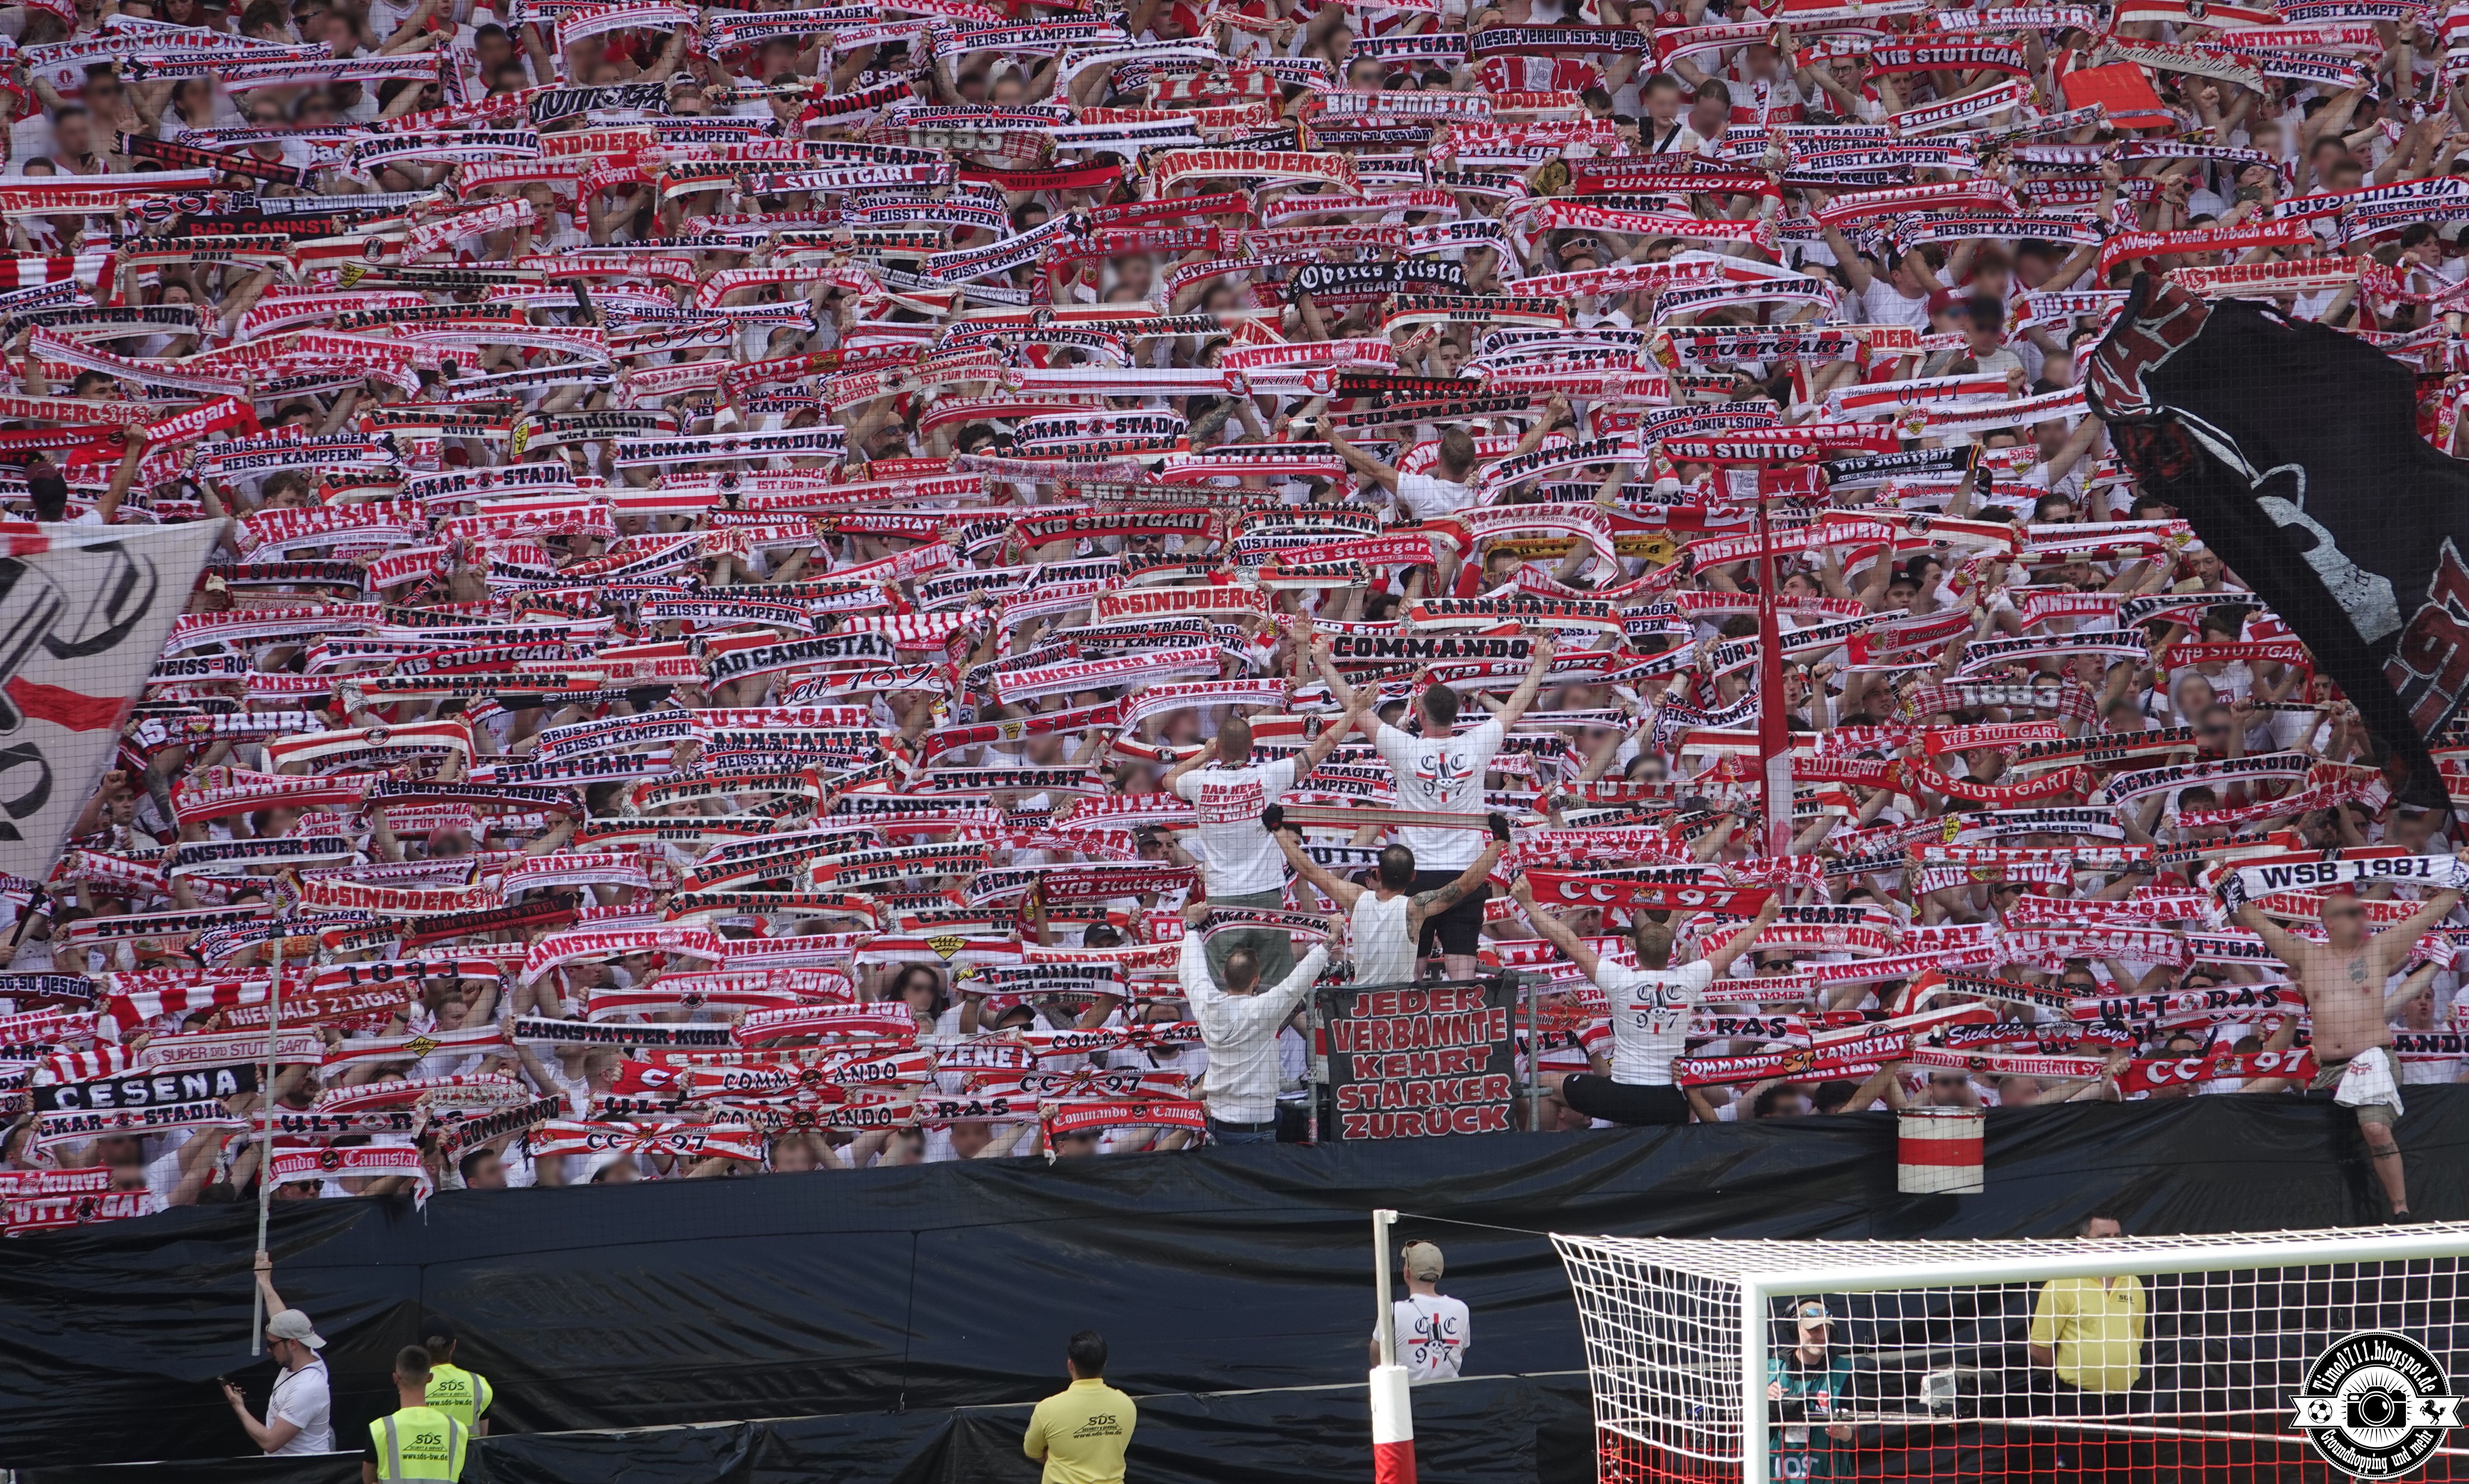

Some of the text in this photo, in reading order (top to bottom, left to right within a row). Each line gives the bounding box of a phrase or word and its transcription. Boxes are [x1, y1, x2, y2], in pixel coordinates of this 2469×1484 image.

[814, 6, 874, 19] TRAGEN
[153, 28, 206, 50] 0711
[1021, 26, 1098, 44] KÄMPFEN!
[1900, 89, 2013, 128] Stuttgart
[1810, 150, 1948, 169] HEISST KÄMPFEN!
[190, 222, 236, 236] BAD
[2170, 229, 2211, 245] Welle
[2214, 225, 2262, 241] Urbach
[1301, 262, 1384, 289] Oberes
[1449, 310, 1491, 320] KURVE
[1686, 339, 1853, 358] STUTTGART
[1897, 382, 1960, 406] 0711
[1347, 396, 1531, 427] COMMANDO
[442, 426, 485, 436] KURVE
[537, 414, 657, 431] Tradition
[222, 448, 362, 471] HEISST KÄMPFEN!
[621, 441, 711, 459] NECKAR
[915, 479, 981, 496] KURVE
[1027, 513, 1208, 536] VfB STUTTGART
[925, 574, 1009, 599] NECKAR
[656, 603, 800, 624] HEISST KÄMPFEN!
[1426, 599, 1611, 617] CANNSTATTER
[1906, 623, 1959, 642] Stuttgart
[1333, 636, 1531, 659] COMMANDO
[2172, 647, 2203, 661] VfB
[554, 724, 691, 757] HEISST KÄMPFEN!
[1940, 726, 2060, 745] VfB STUTTGART
[2084, 749, 2127, 761] KURVE
[494, 754, 649, 784] STUTTGART
[1801, 758, 1887, 777] STUTTGART
[934, 770, 1083, 789] STUTTGART
[1950, 767, 2070, 800] STUTTGART
[648, 777, 806, 804] IST DER 12. MANN!
[657, 830, 701, 839] KURVE
[840, 853, 893, 867] JEDER
[837, 871, 861, 886] IST
[867, 867, 901, 881] DER
[907, 864, 929, 877] 12.
[2006, 863, 2071, 884] STOLZ
[2261, 858, 2432, 889] WSB 1981
[1050, 881, 1091, 895] VfB
[1676, 888, 1738, 906] 97
[97, 910, 257, 938] STUTTGART
[978, 964, 1114, 983] Tradition
[1055, 980, 1095, 989] siegen!
[1350, 985, 1486, 1018] JEDER
[2208, 985, 2281, 1009] RAS
[516, 1022, 669, 1043] CANNSTATTER
[1331, 1007, 1507, 1053] VERBANNTE
[1716, 1017, 1788, 1038] RAS
[2086, 1023, 2128, 1043] Boys
[162, 1048, 207, 1061] SUPER
[1353, 1045, 1493, 1081] KEHRT
[2254, 1050, 2309, 1073] 97
[1679, 1056, 1782, 1077] COMMANDO
[54, 1072, 238, 1110] CESENA
[1105, 1076, 1141, 1092] 97
[1337, 1073, 1512, 1111] STÄRKER
[937, 1098, 1010, 1118] RAS
[459, 1097, 560, 1147] COMMANDO
[1342, 1104, 1511, 1140] ZURÜCK
[670, 1134, 707, 1151] 97
[439, 1381, 465, 1391] SDS
[1088, 1415, 1117, 1424] SDS
[416, 1434, 442, 1444] SDS
[402, 1453, 448, 1461] www.sds-bw.de
